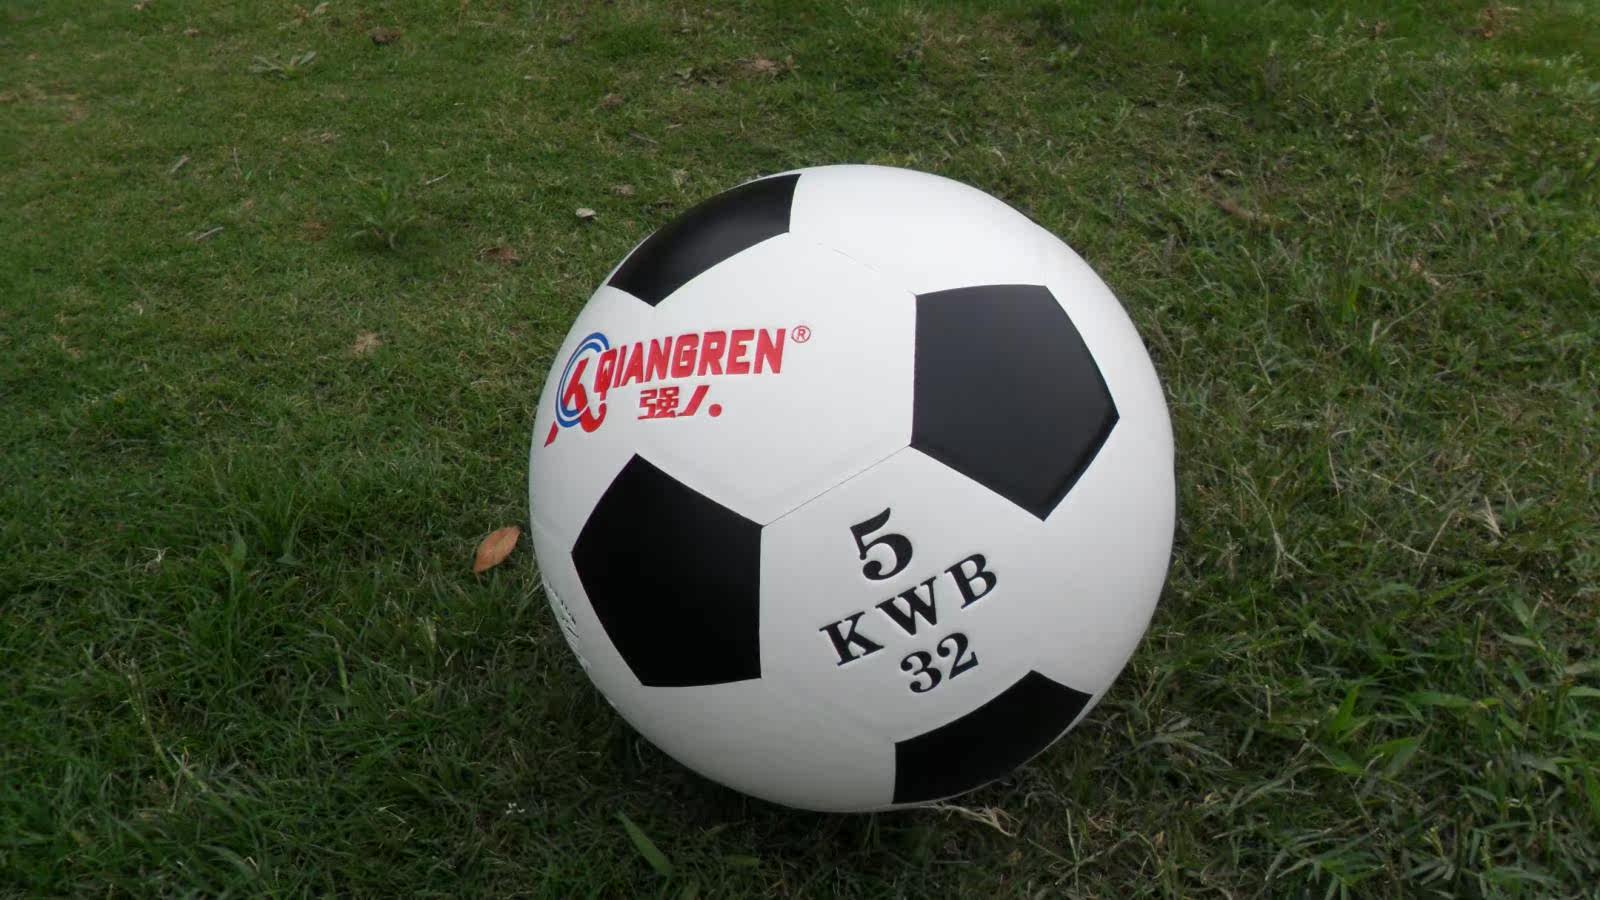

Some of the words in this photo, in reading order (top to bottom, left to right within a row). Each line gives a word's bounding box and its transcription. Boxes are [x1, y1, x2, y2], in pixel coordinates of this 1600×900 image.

[593, 328, 786, 400] QIANGREN
[849, 507, 914, 581] 5
[818, 553, 997, 666] KWB
[900, 632, 979, 693] 32
